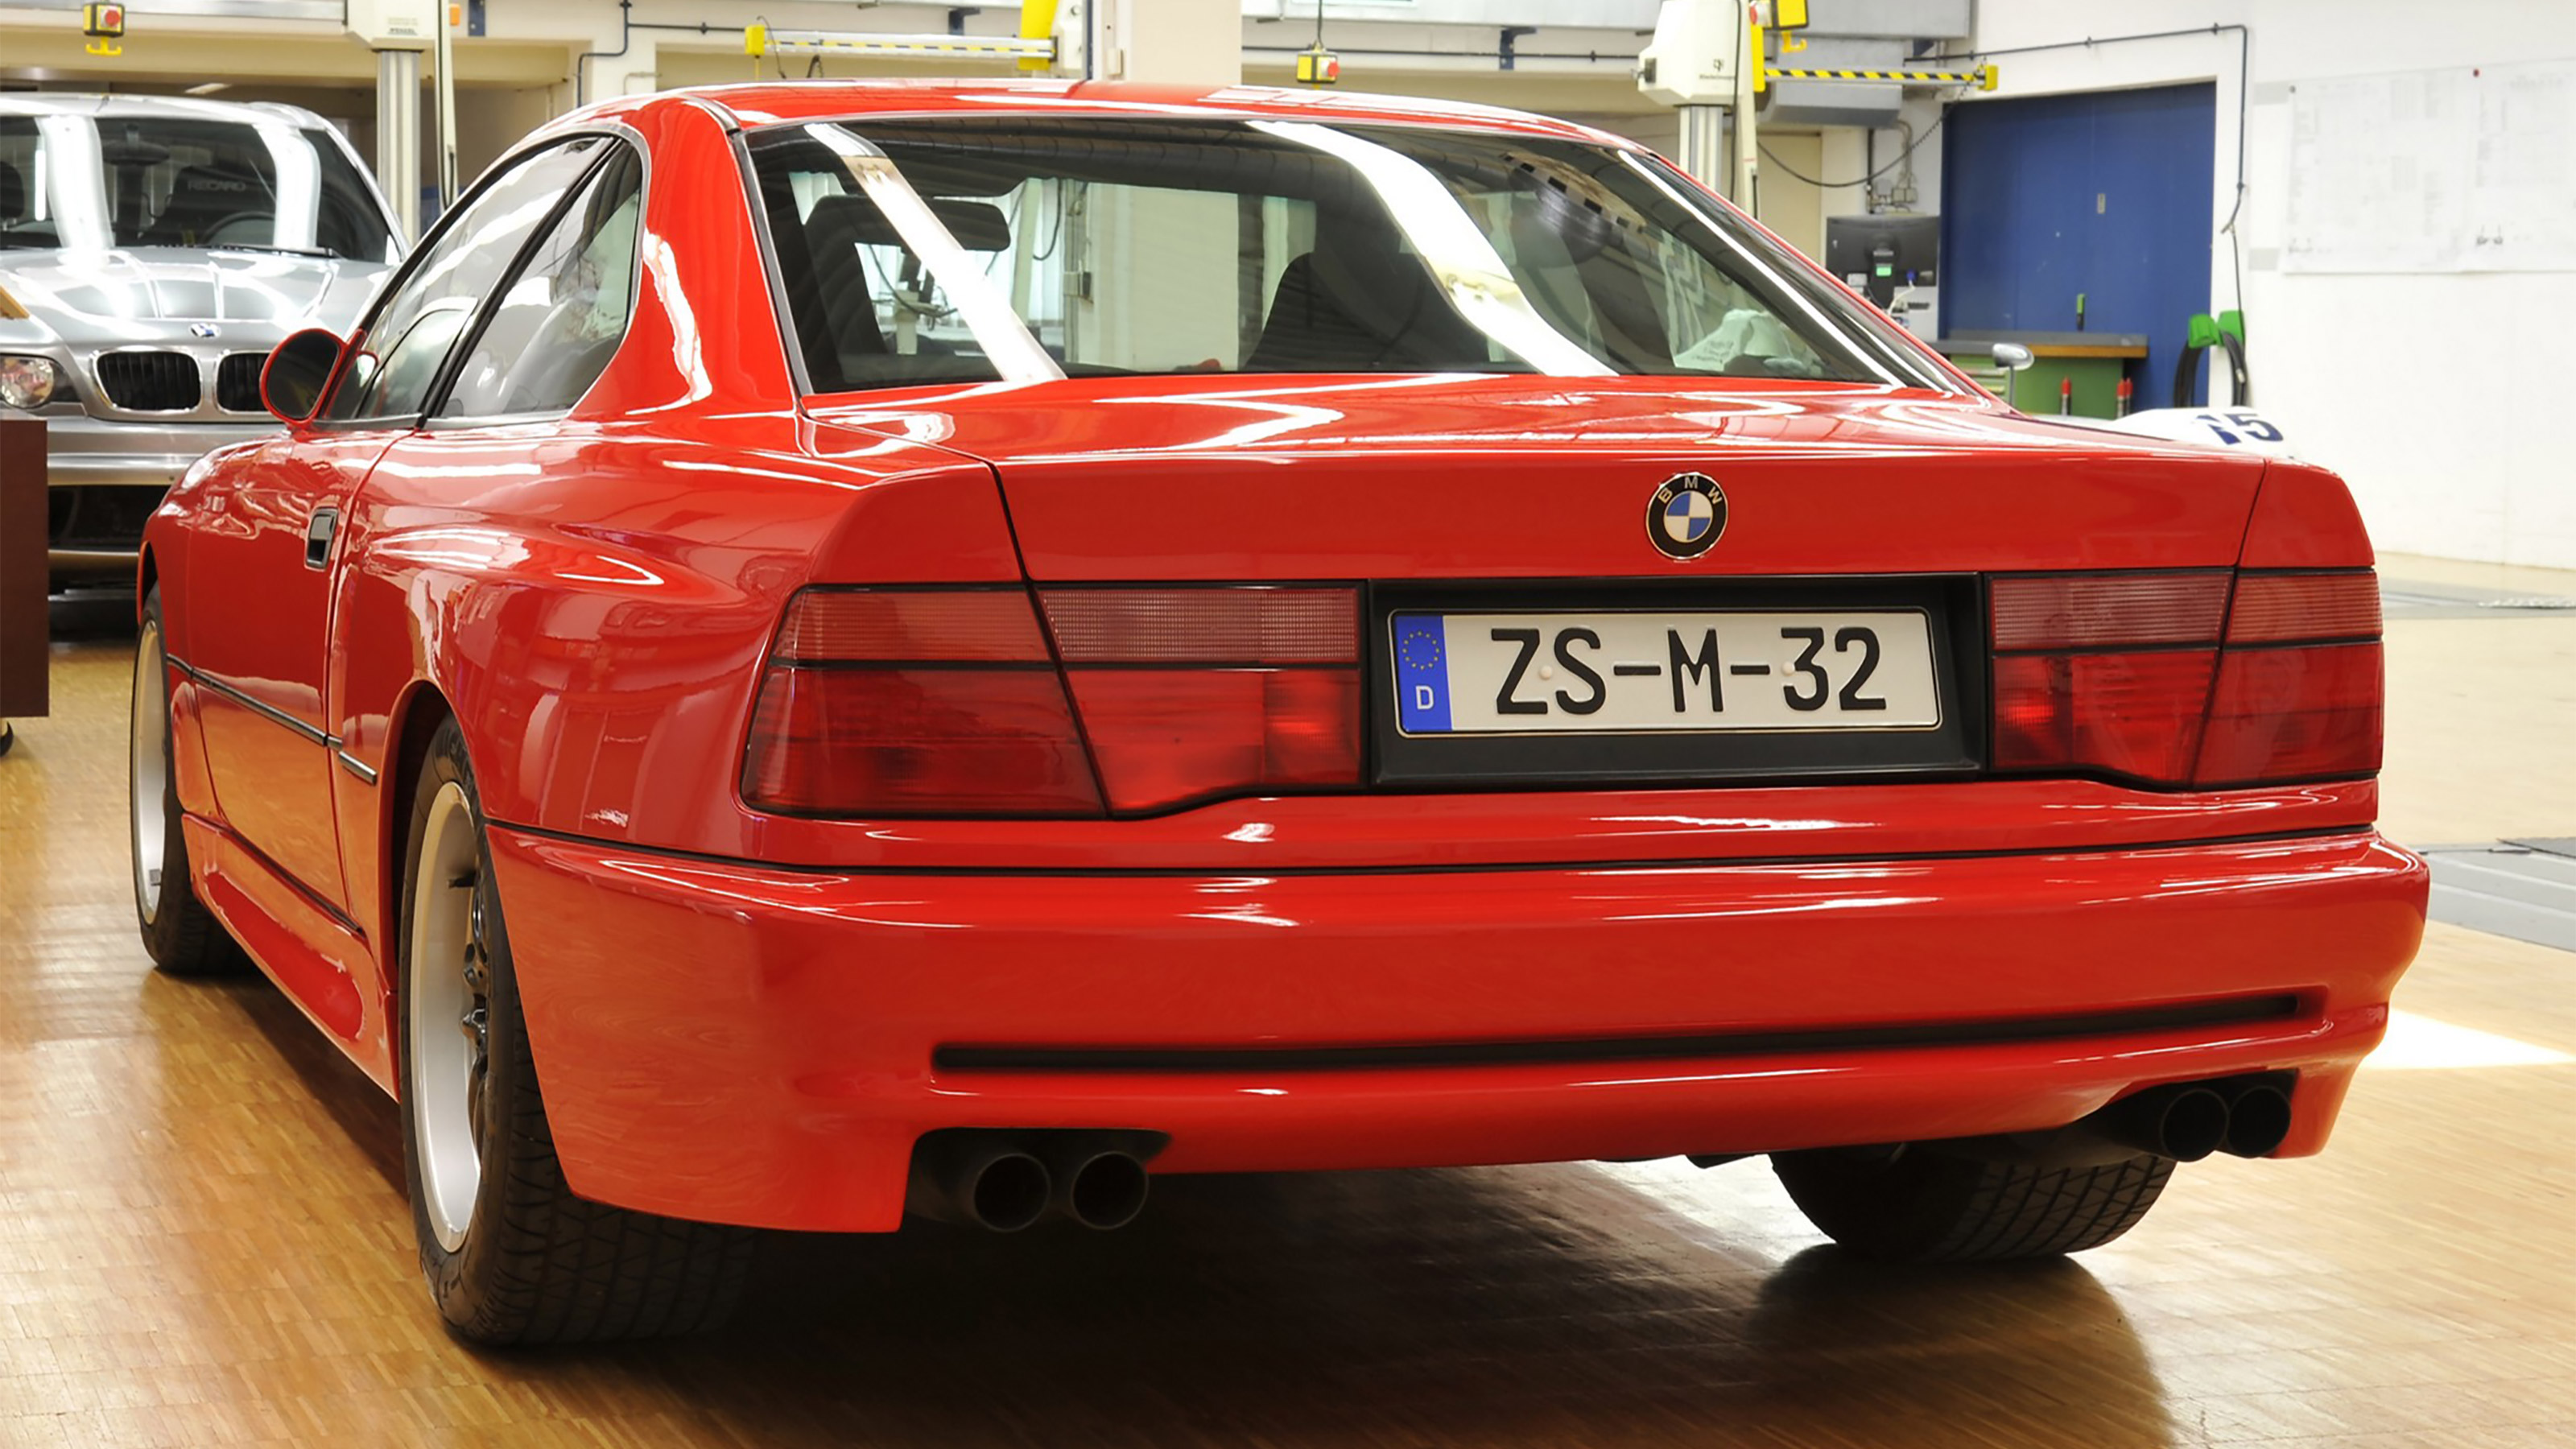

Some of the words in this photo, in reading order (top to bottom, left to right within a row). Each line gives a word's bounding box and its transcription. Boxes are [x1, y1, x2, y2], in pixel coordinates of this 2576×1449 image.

[1657, 476, 1723, 504] BMW
[1491, 627, 1887, 715] ZS-M-32
[1415, 685, 1435, 710] D
